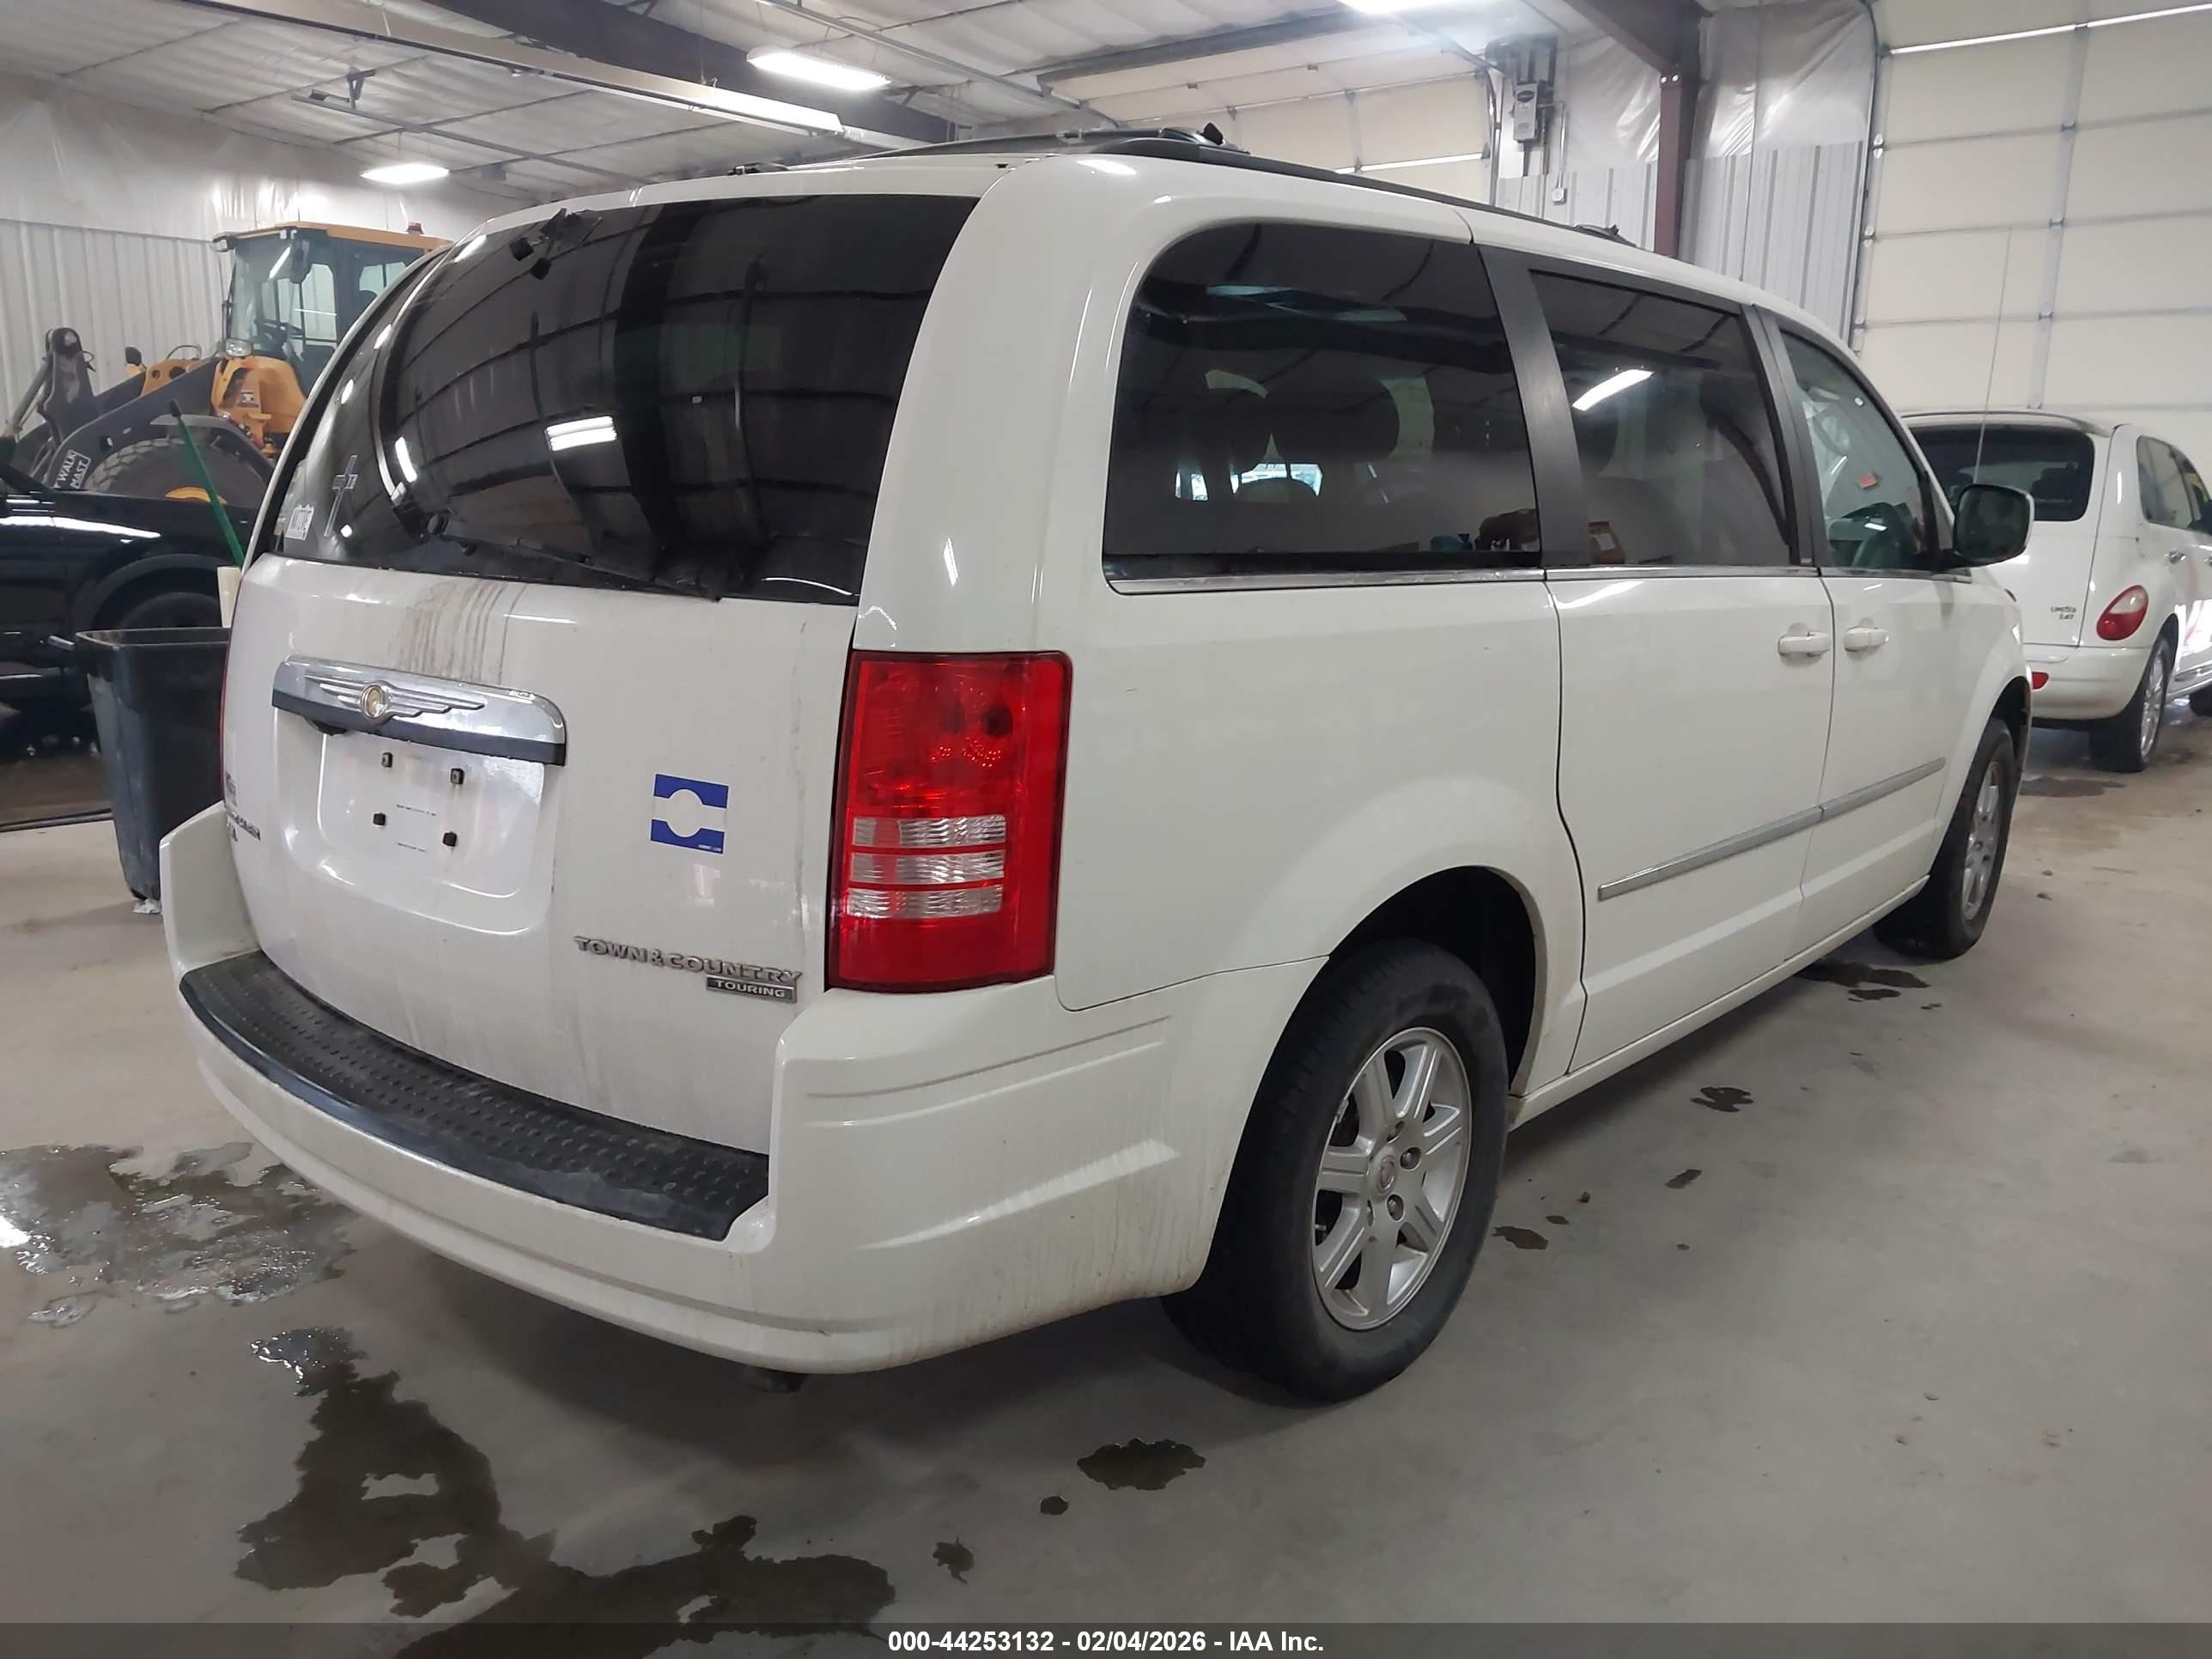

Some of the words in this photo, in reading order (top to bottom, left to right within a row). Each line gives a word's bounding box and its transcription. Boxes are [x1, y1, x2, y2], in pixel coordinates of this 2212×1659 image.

[57, 453, 76, 481] WALK
[70, 460, 87, 489] MAST
[716, 979, 786, 998] TOURING
